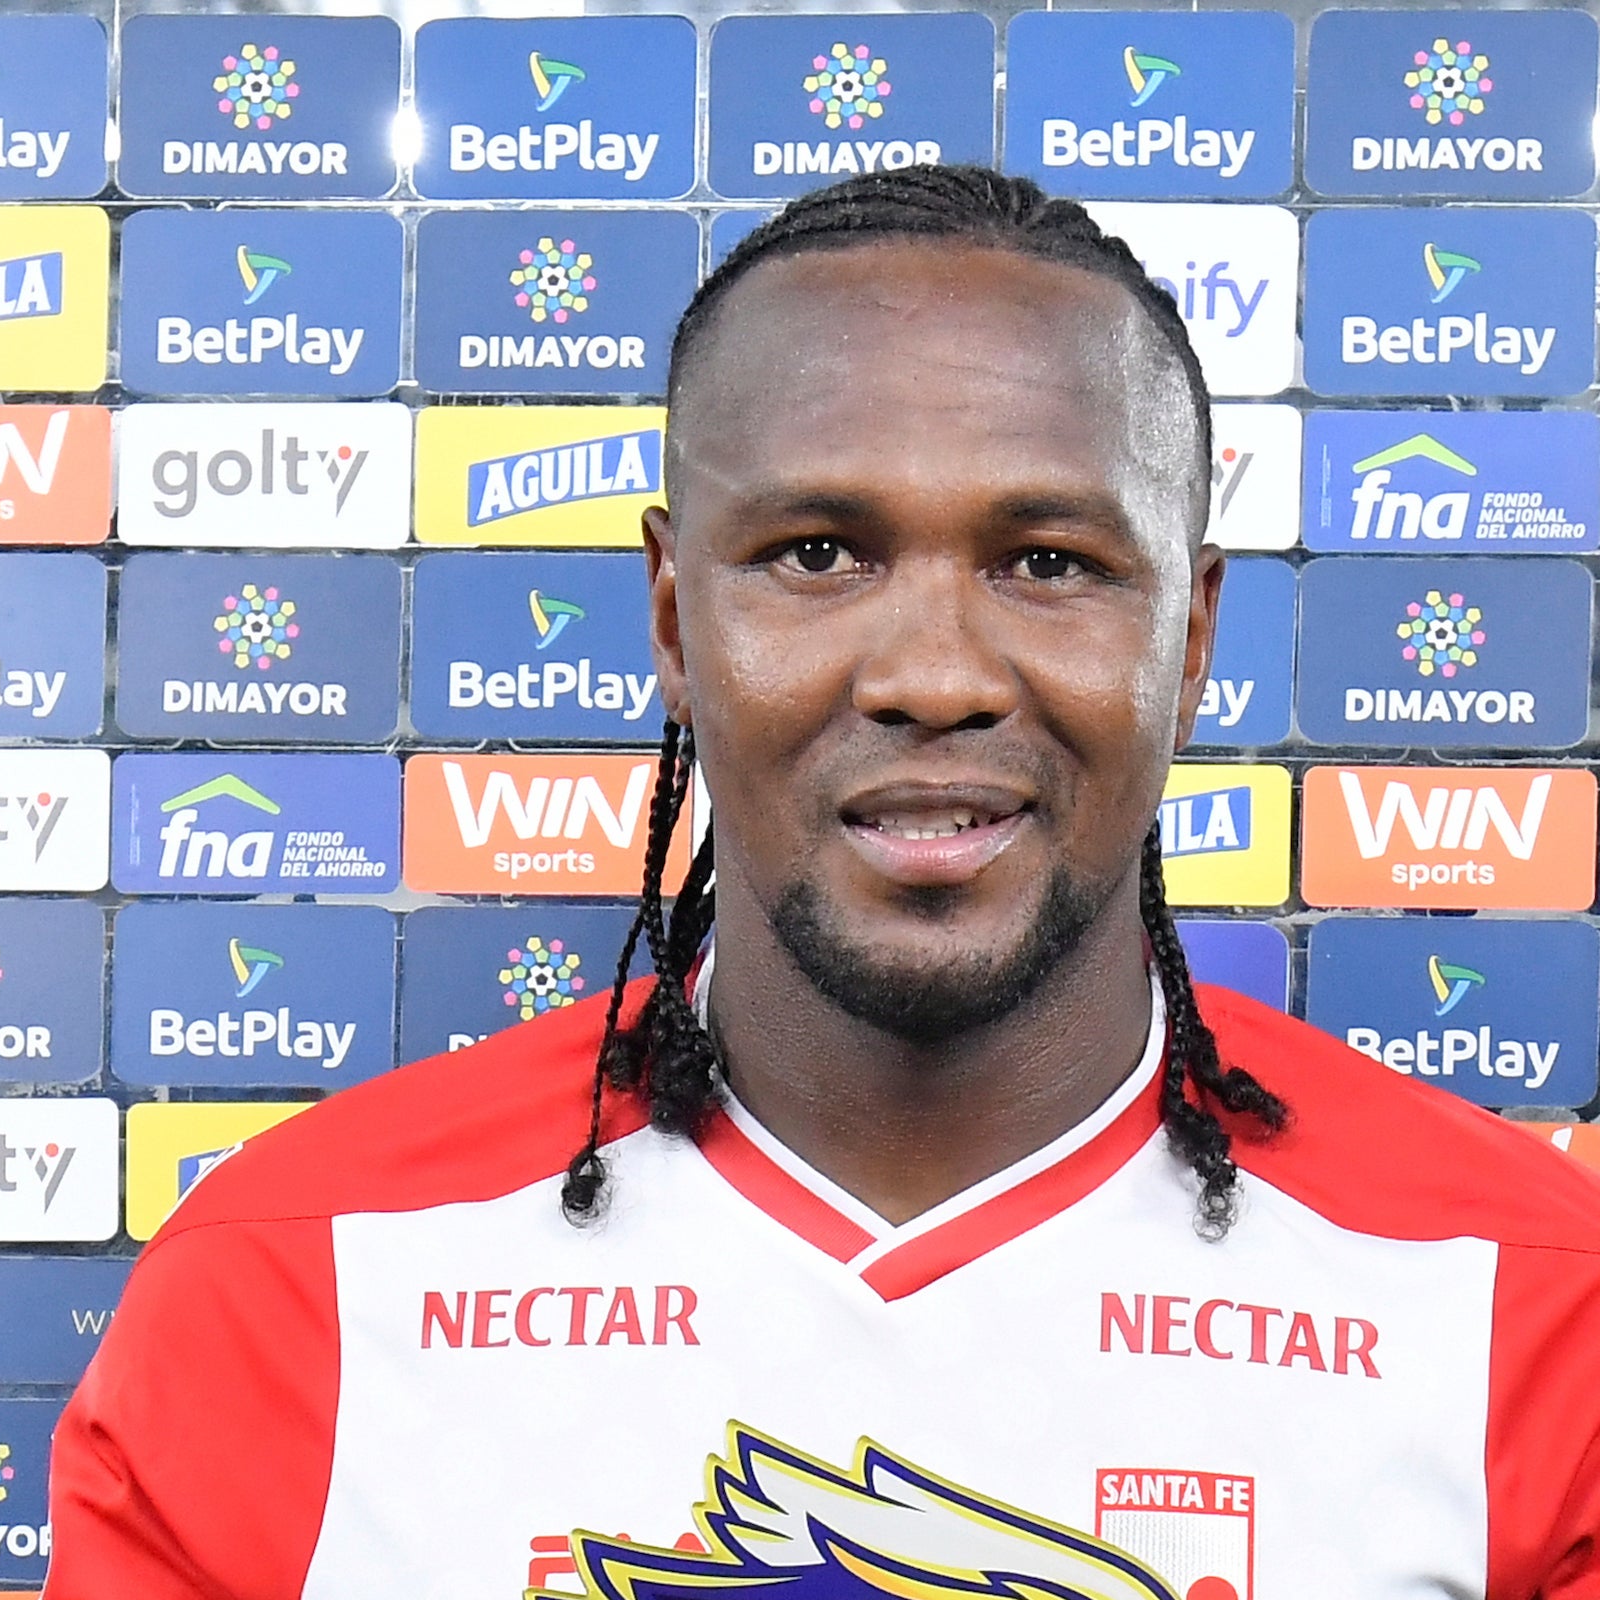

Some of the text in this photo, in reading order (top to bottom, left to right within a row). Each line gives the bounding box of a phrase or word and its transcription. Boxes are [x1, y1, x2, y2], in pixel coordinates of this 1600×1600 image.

[164, 142, 347, 174] DIMAYOR
[451, 120, 659, 180] BetPlay
[754, 141, 941, 175] DIMAYOR
[1043, 116, 1254, 177] BetPlay
[1353, 138, 1542, 170] DIMAYOR
[158, 314, 363, 374] BetPlay
[460, 336, 644, 368] DIMAYOR
[1343, 313, 1555, 374] BetPlay
[153, 429, 369, 518] golty
[476, 436, 651, 520] AGUILA
[1351, 470, 1469, 539] fna
[1480, 509, 1566, 523] NACIONAL
[1483, 493, 1542, 507] FONDO
[1476, 524, 1585, 538] DEL AHORRO
[164, 681, 346, 715] DIMAYOR
[449, 659, 657, 720] BetPlay
[1346, 689, 1534, 723] DIMAYOR
[443, 762, 651, 848] WIN
[1339, 771, 1552, 860] WIN
[159, 809, 273, 877] fna
[283, 847, 367, 861] NACIONAL
[287, 832, 343, 846] FONDO
[280, 862, 385, 877] DEL AHORRO
[494, 849, 595, 879] sports
[1392, 860, 1495, 890] sports
[151, 1008, 356, 1068] BetPlay
[1347, 1026, 1559, 1088] BetPlay
[422, 1286, 698, 1348] NECTAR
[1101, 1293, 1379, 1378] NECTAR
[1102, 1475, 1249, 1511] SANTA FE
